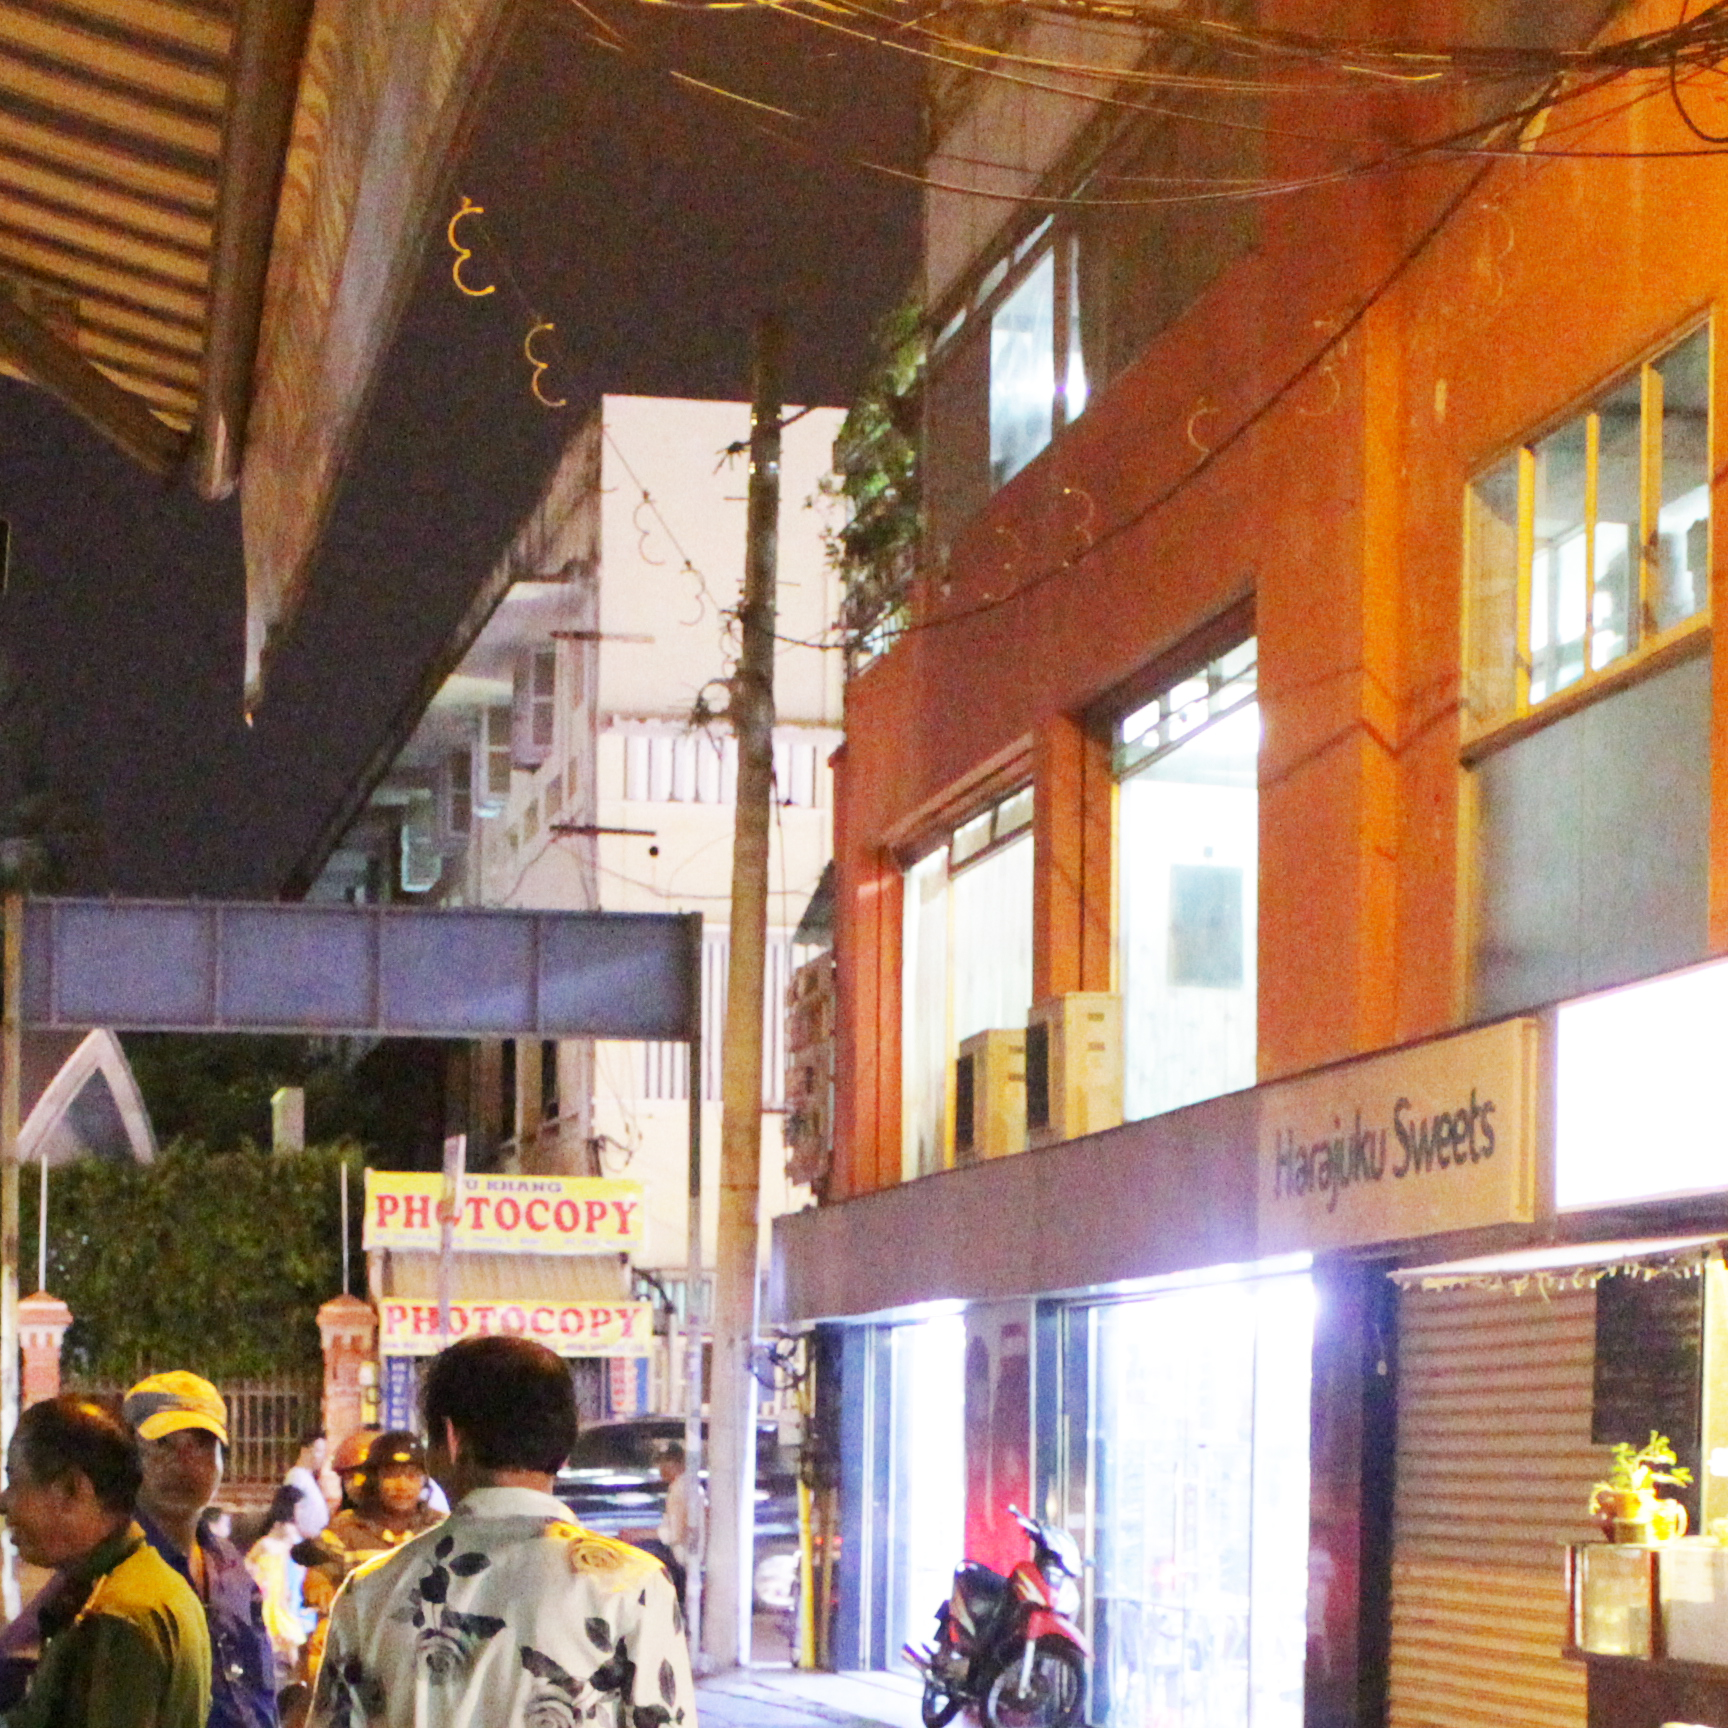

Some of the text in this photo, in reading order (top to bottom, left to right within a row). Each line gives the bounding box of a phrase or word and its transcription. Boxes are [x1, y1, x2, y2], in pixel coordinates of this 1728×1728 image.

[1274, 1087, 1496, 1214] Harajuku Sweets
[385, 1304, 643, 1338] PHOTOCOPY
